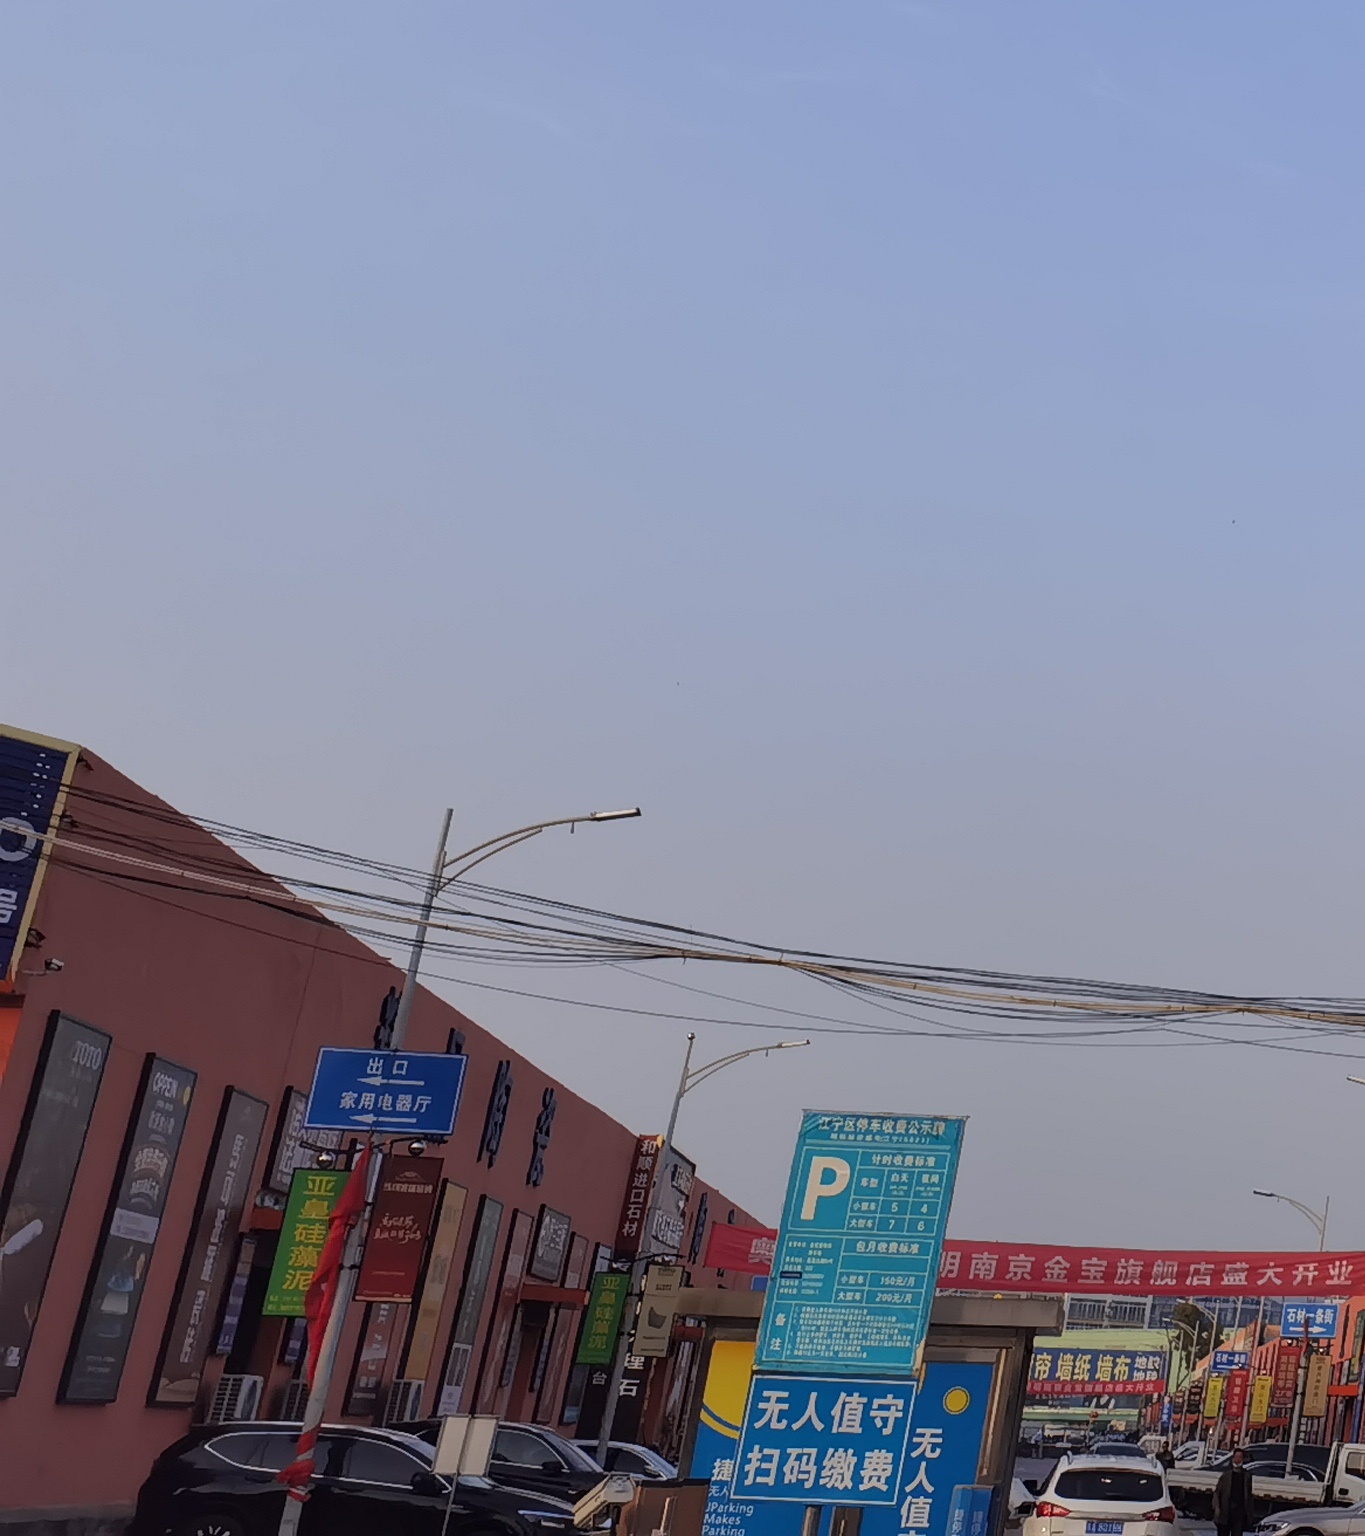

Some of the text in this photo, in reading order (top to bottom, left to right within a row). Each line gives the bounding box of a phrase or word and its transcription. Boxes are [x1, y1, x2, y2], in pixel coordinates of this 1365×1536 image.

[367, 1057, 408, 1076] 出口
[339, 1091, 432, 1113] 家用电器厅
[818, 1116, 946, 1136] 江宁区停车收费公示牌
[622, 1138, 658, 1238] 和顺进口石材
[801, 1155, 850, 1221] P
[891, 1202, 898, 1212] 5
[920, 1203, 928, 1214] 4
[282, 1175, 337, 1292] 亚皇硅藻泥
[888, 1219, 896, 1230] 7
[938, 1250, 1354, 1287] 明南京金宝旗舰店盛大开业
[1287, 1308, 1334, 1325] 石材一条街
[1028, 1351, 1131, 1382] 帘 墙纸 墙布
[753, 1390, 905, 1436] 无人值守
[712, 1457, 736, 1482] 捷
[743, 1444, 893, 1492] 扫码缴费
[703, 1513, 741, 1526] Makes
[705, 1502, 754, 1516] JParking
[702, 1525, 745, 1536] Parking
